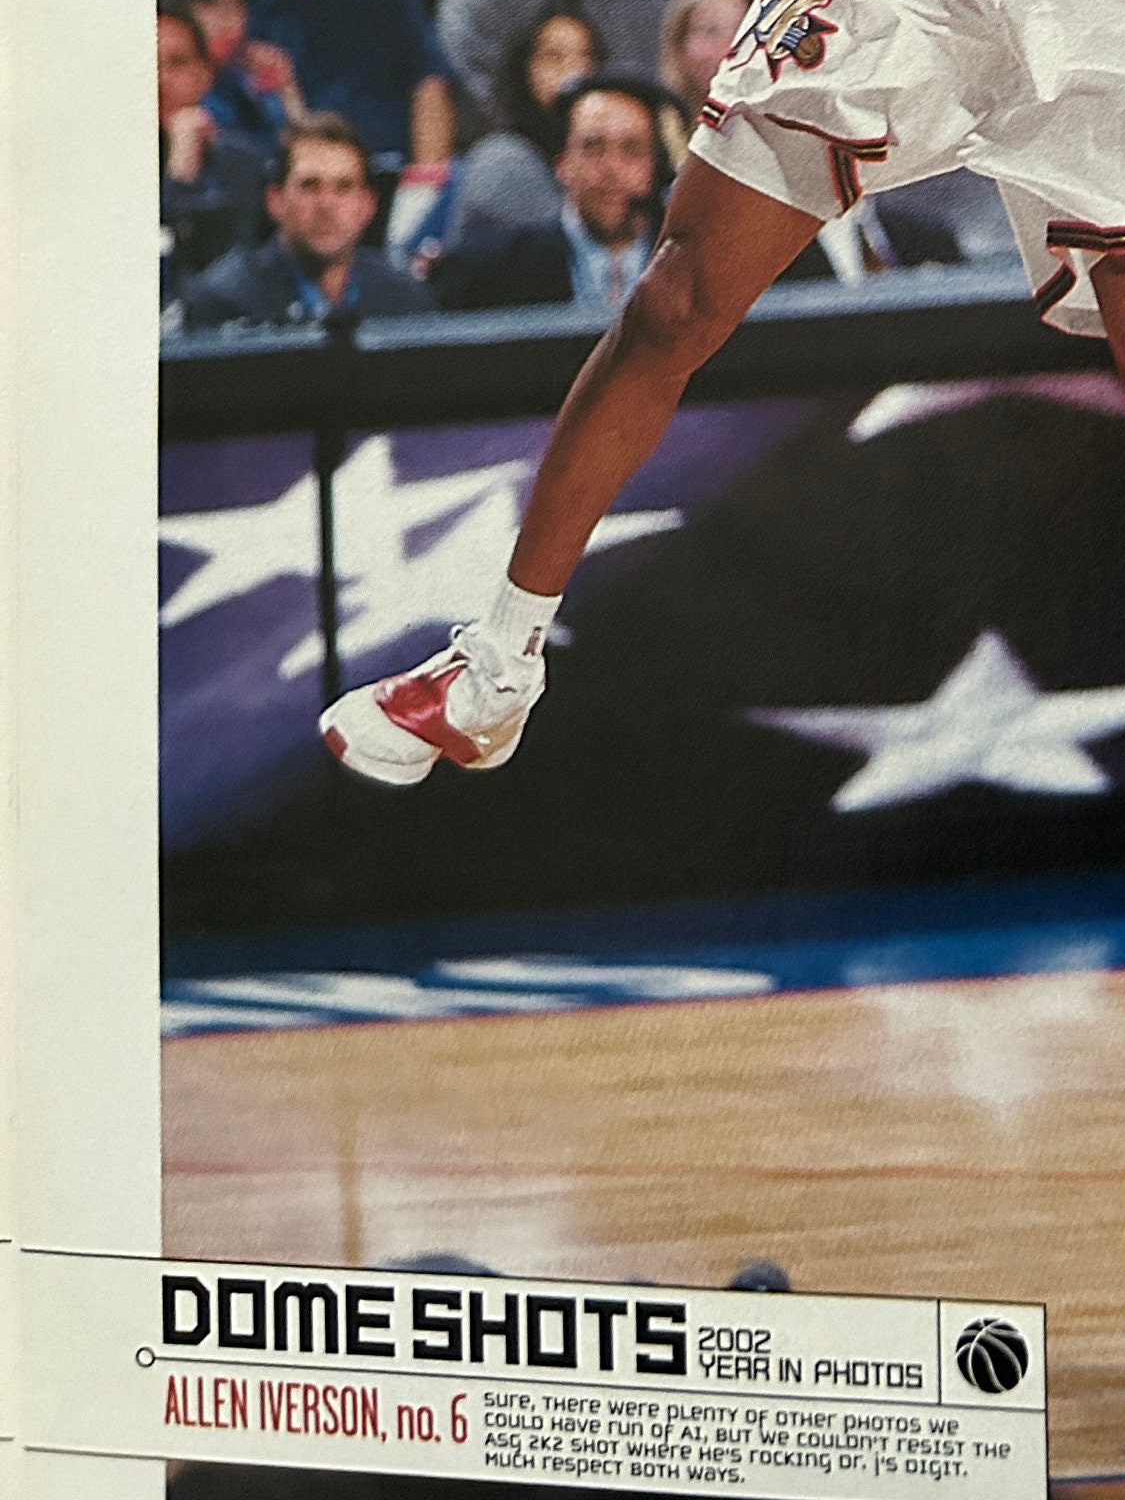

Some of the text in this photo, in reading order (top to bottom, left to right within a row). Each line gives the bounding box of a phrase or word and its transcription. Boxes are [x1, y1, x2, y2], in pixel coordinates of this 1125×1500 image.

[162, 1275, 687, 1376] DOME SHOTS
[699, 1326, 771, 1354] 2002
[700, 1353, 923, 1389] YEAR IN PHOTOS
[164, 1374, 468, 1444] ALLEN IVERSON, no. 6
